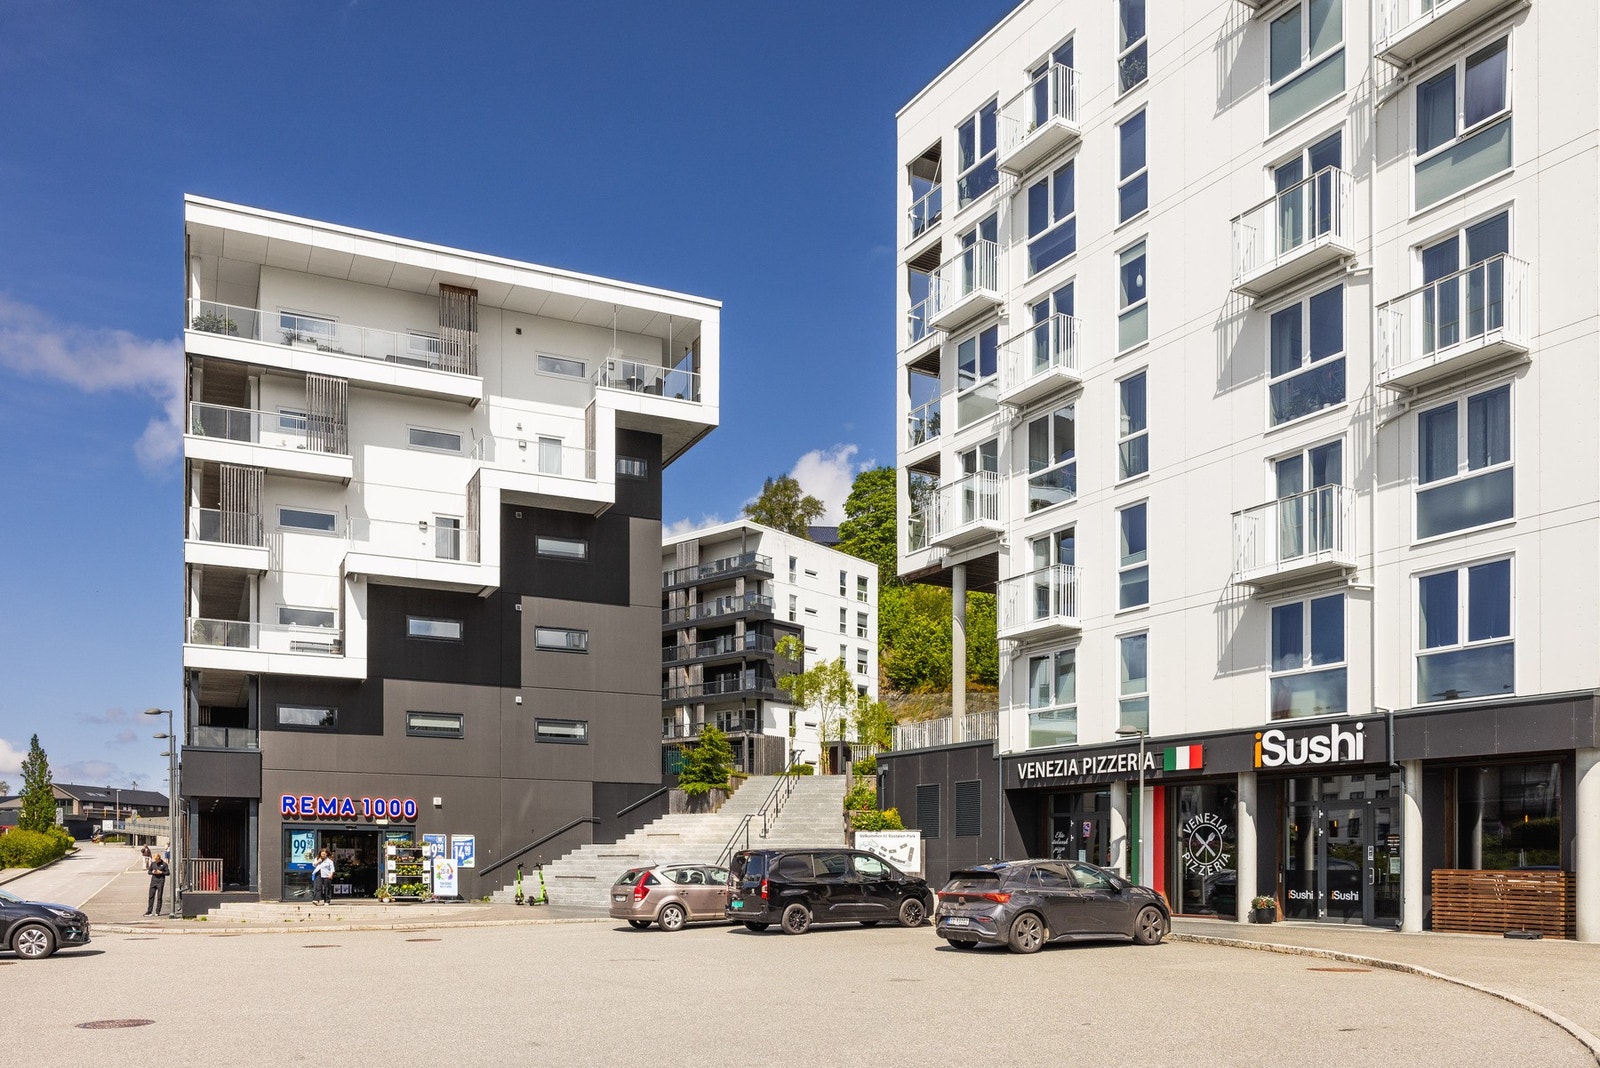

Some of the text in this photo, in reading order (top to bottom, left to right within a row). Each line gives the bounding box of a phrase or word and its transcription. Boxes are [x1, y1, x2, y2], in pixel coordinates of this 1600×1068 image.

[1254, 722, 1364, 768] iSushi
[1017, 751, 1156, 780] VENEZIA PIZZERIA
[281, 794, 417, 818] REMA 1000
[1183, 812, 1228, 835] VENEZIA
[293, 839, 306, 854] 99
[1181, 851, 1231, 876] PIZZERIA
[1288, 889, 1314, 900] iSushi
[1331, 890, 1359, 901] iSushi
